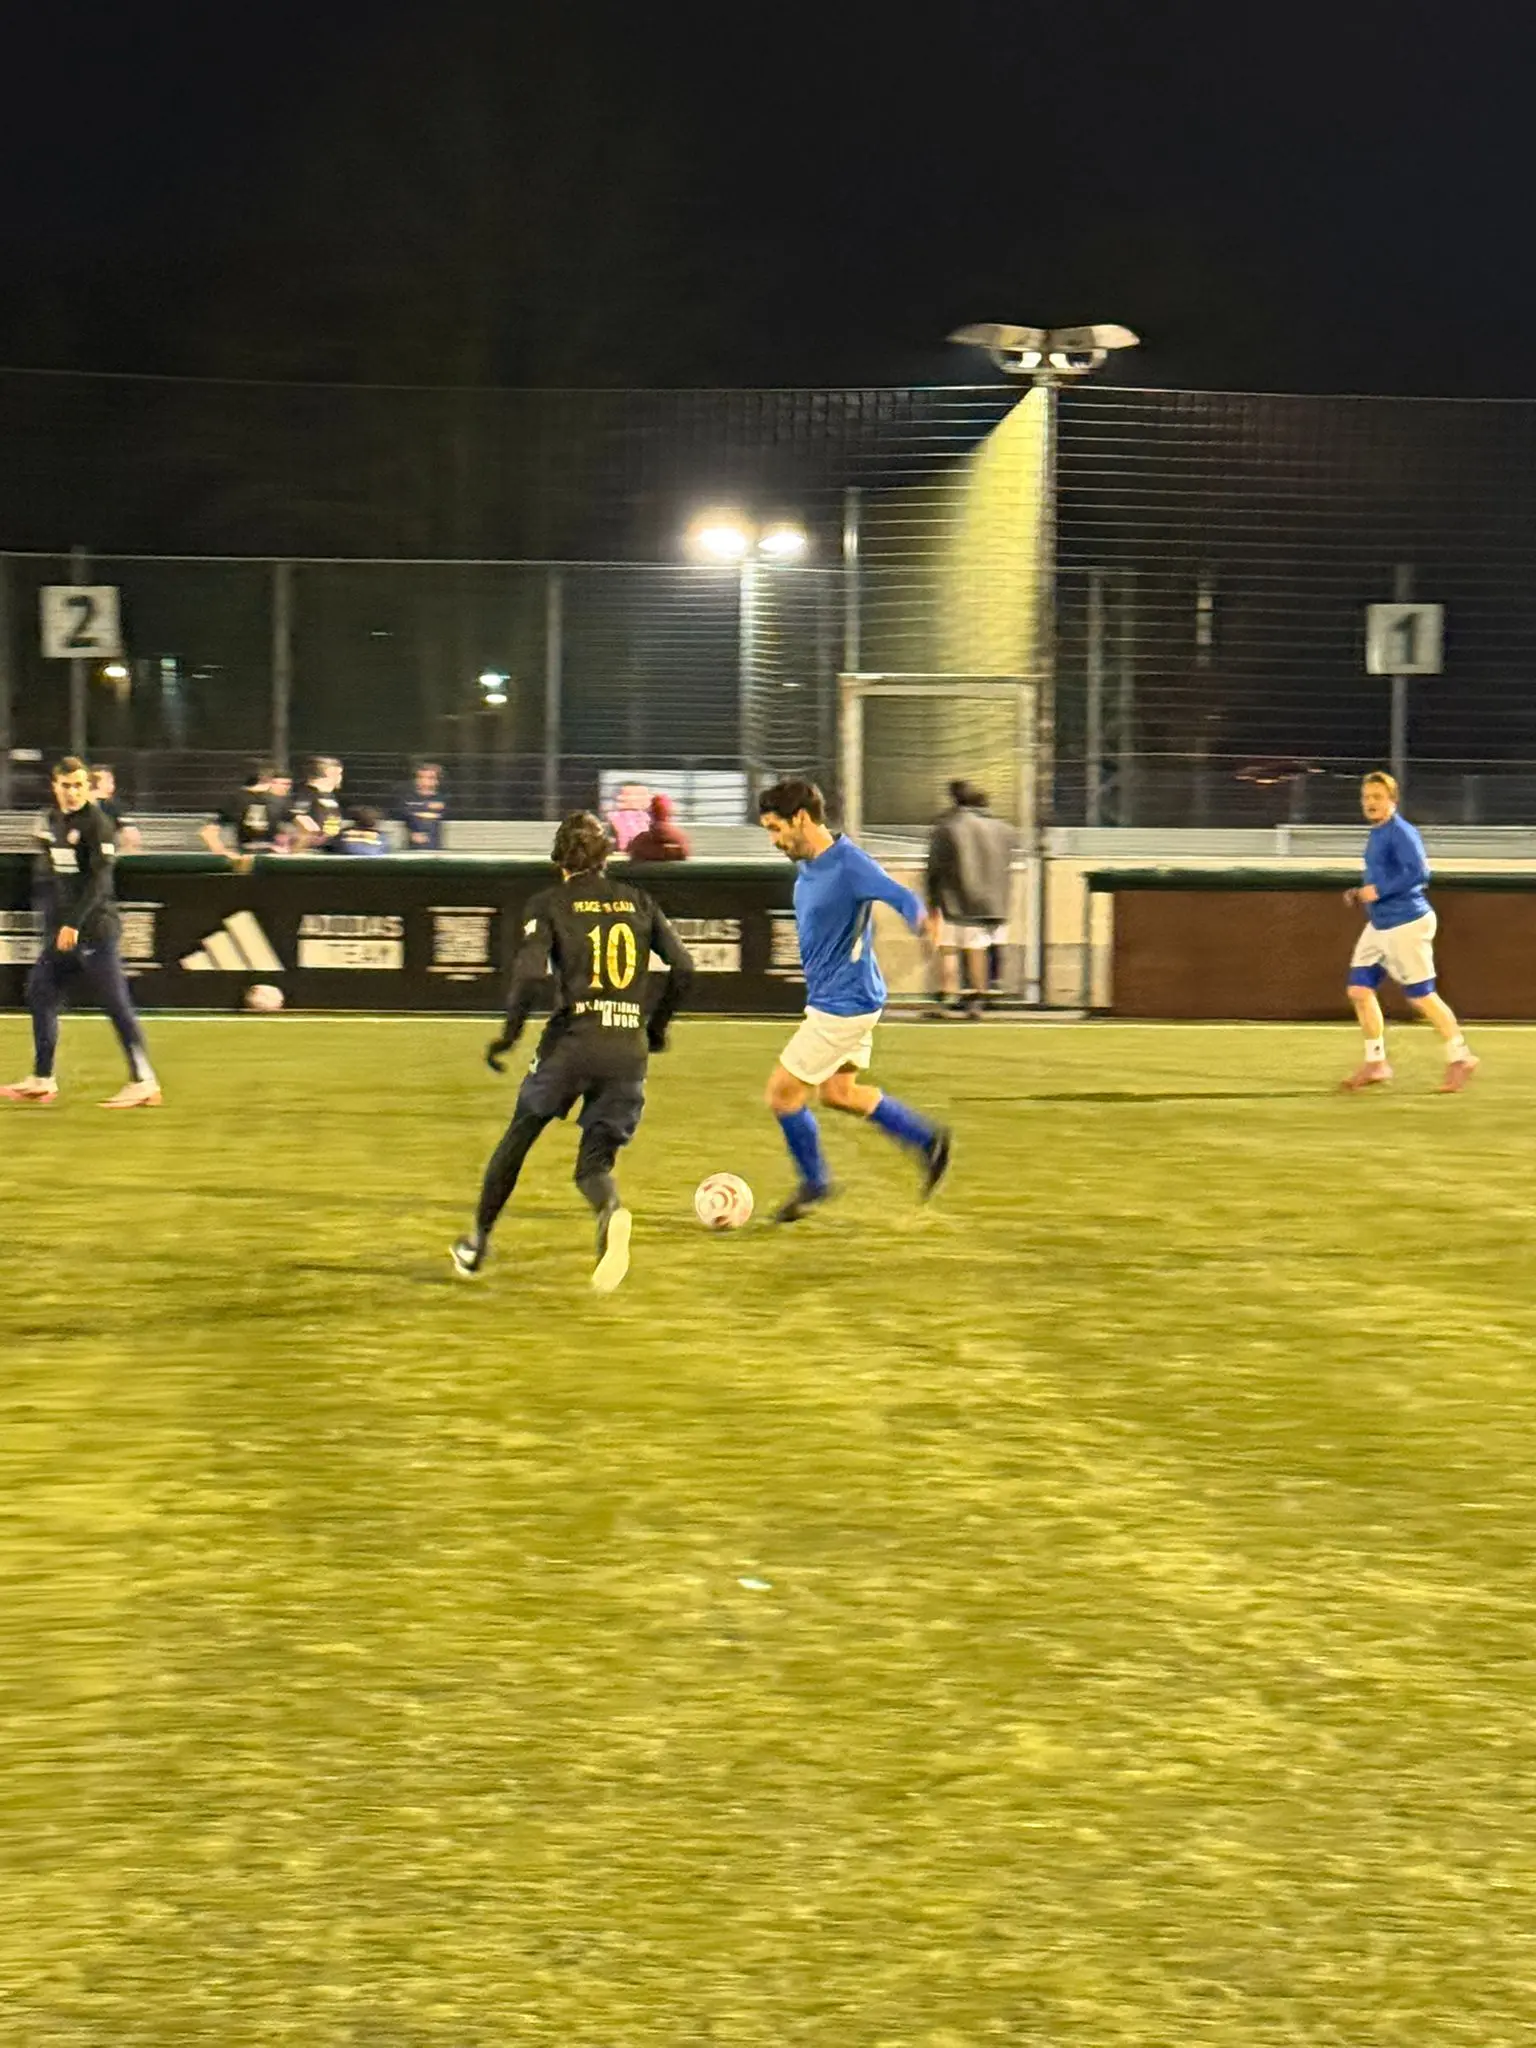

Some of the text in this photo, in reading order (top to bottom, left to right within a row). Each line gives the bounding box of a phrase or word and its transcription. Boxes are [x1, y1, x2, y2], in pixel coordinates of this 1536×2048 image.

[65, 594, 99, 648] 2
[1389, 612, 1420, 664] 1
[587, 922, 637, 989] 10
